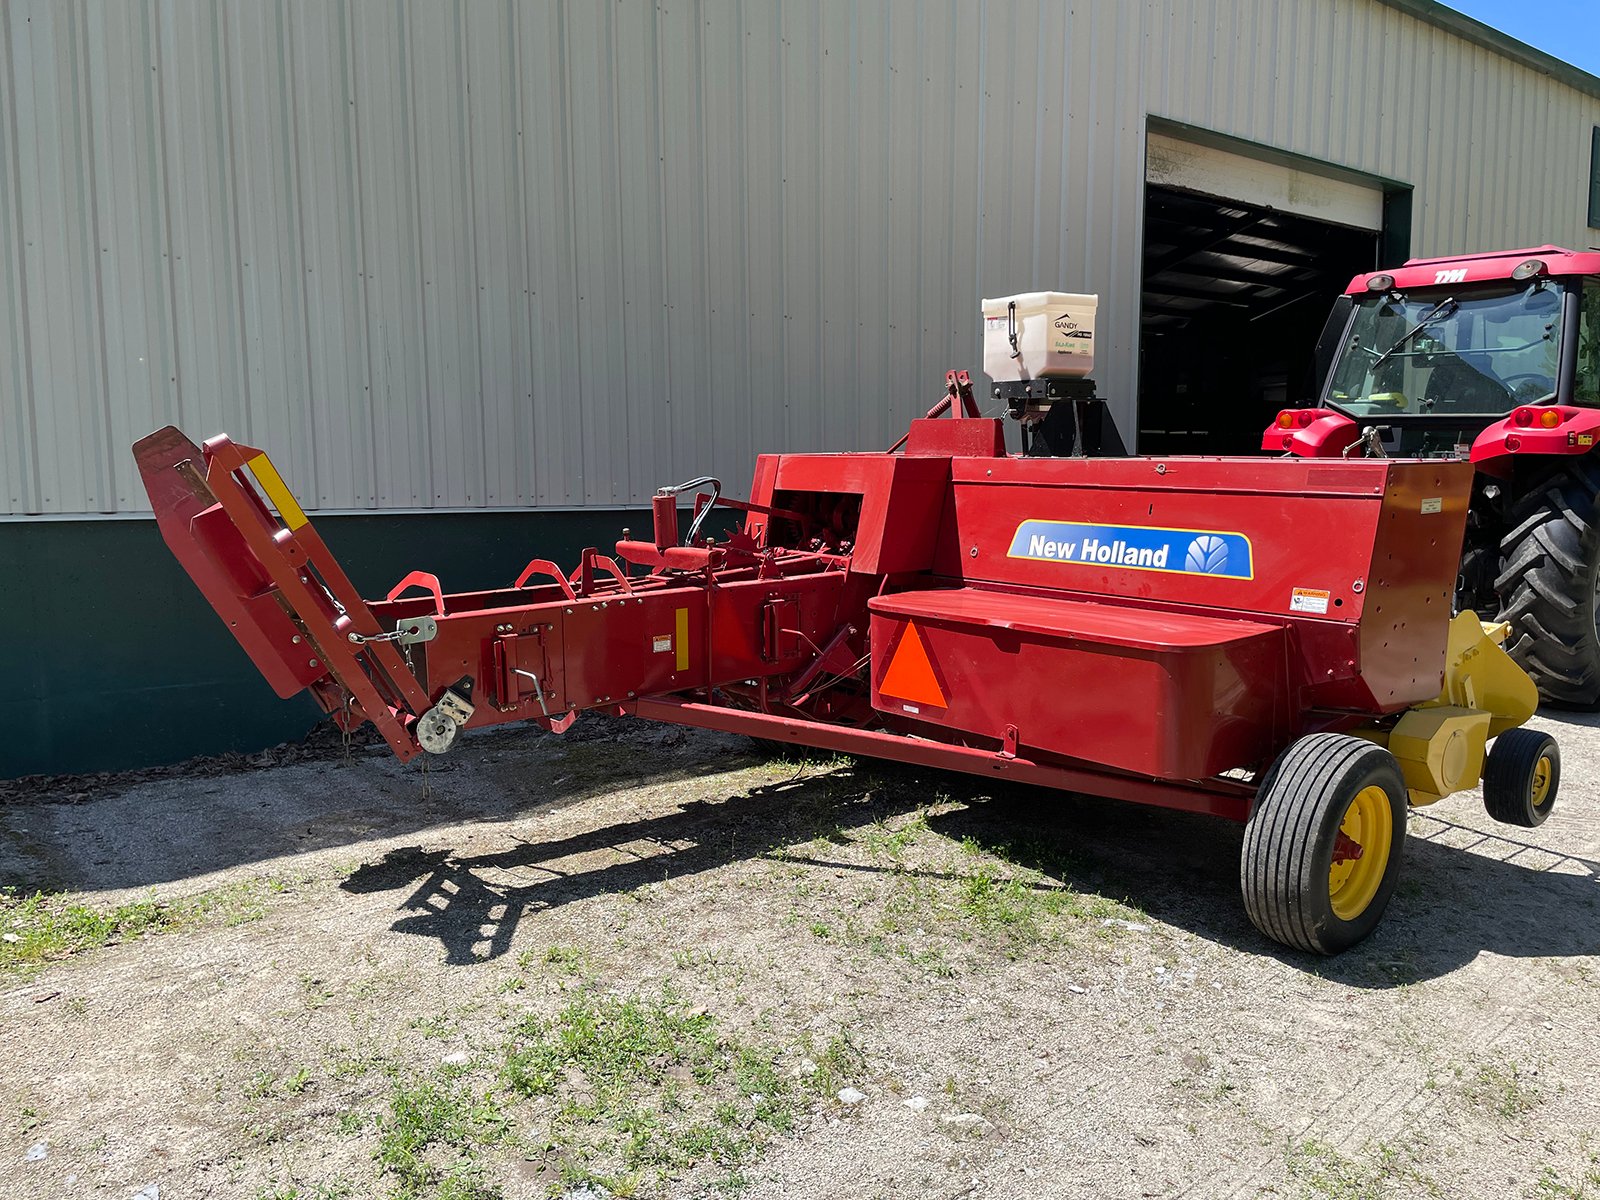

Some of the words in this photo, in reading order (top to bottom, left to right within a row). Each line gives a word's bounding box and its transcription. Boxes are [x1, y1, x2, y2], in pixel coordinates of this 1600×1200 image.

[1054, 321, 1078, 329] GANDY
[1028, 534, 1076, 559] New
[1081, 538, 1169, 568] Holland
